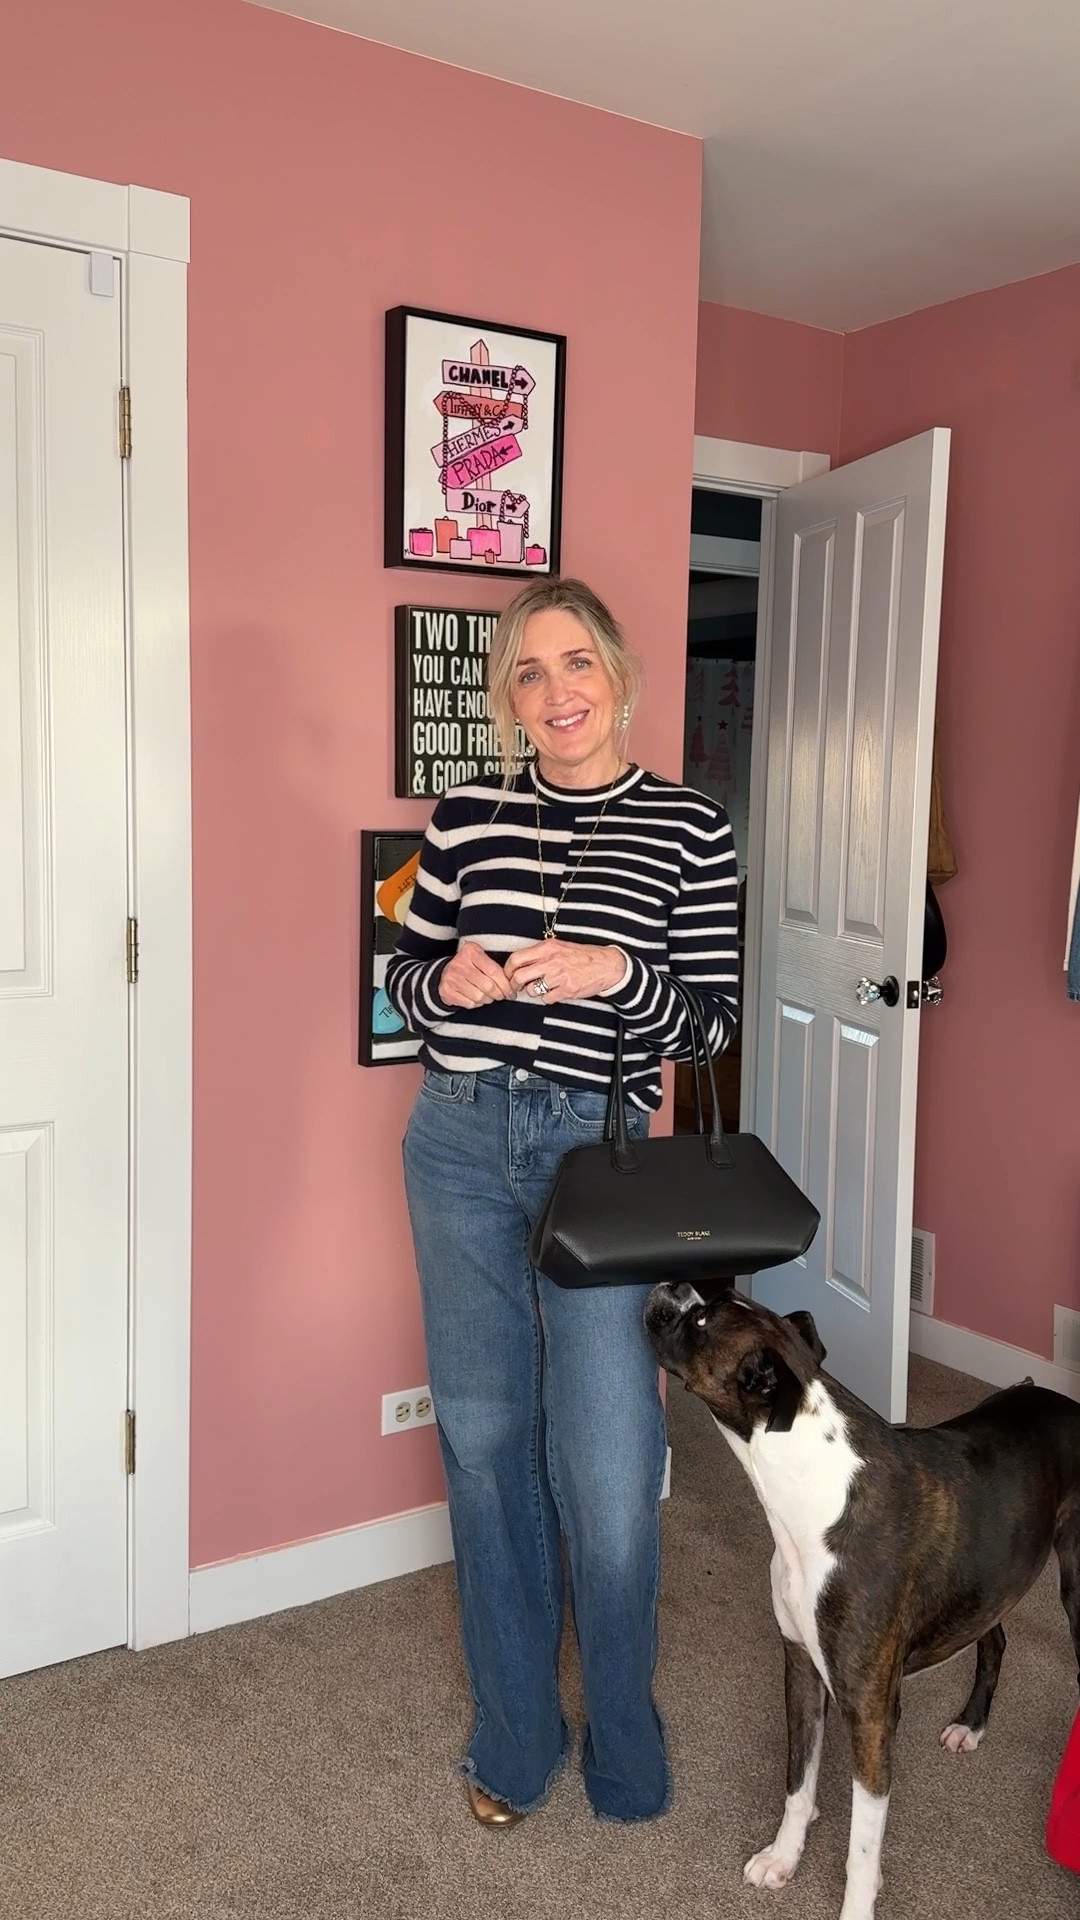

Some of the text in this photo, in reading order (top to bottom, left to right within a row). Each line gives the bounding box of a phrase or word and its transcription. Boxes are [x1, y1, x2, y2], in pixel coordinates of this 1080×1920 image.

[449, 365, 509, 388] CHANEL
[447, 426, 501, 458] HERMES
[451, 445, 505, 485] PRADA
[461, 492, 497, 513] Dior
[412, 611, 459, 651] TWO
[413, 654, 483, 686] YOU CAN
[413, 688, 453, 718] HAVE
[412, 721, 462, 756] GOOD
[412, 760, 426, 795] &
